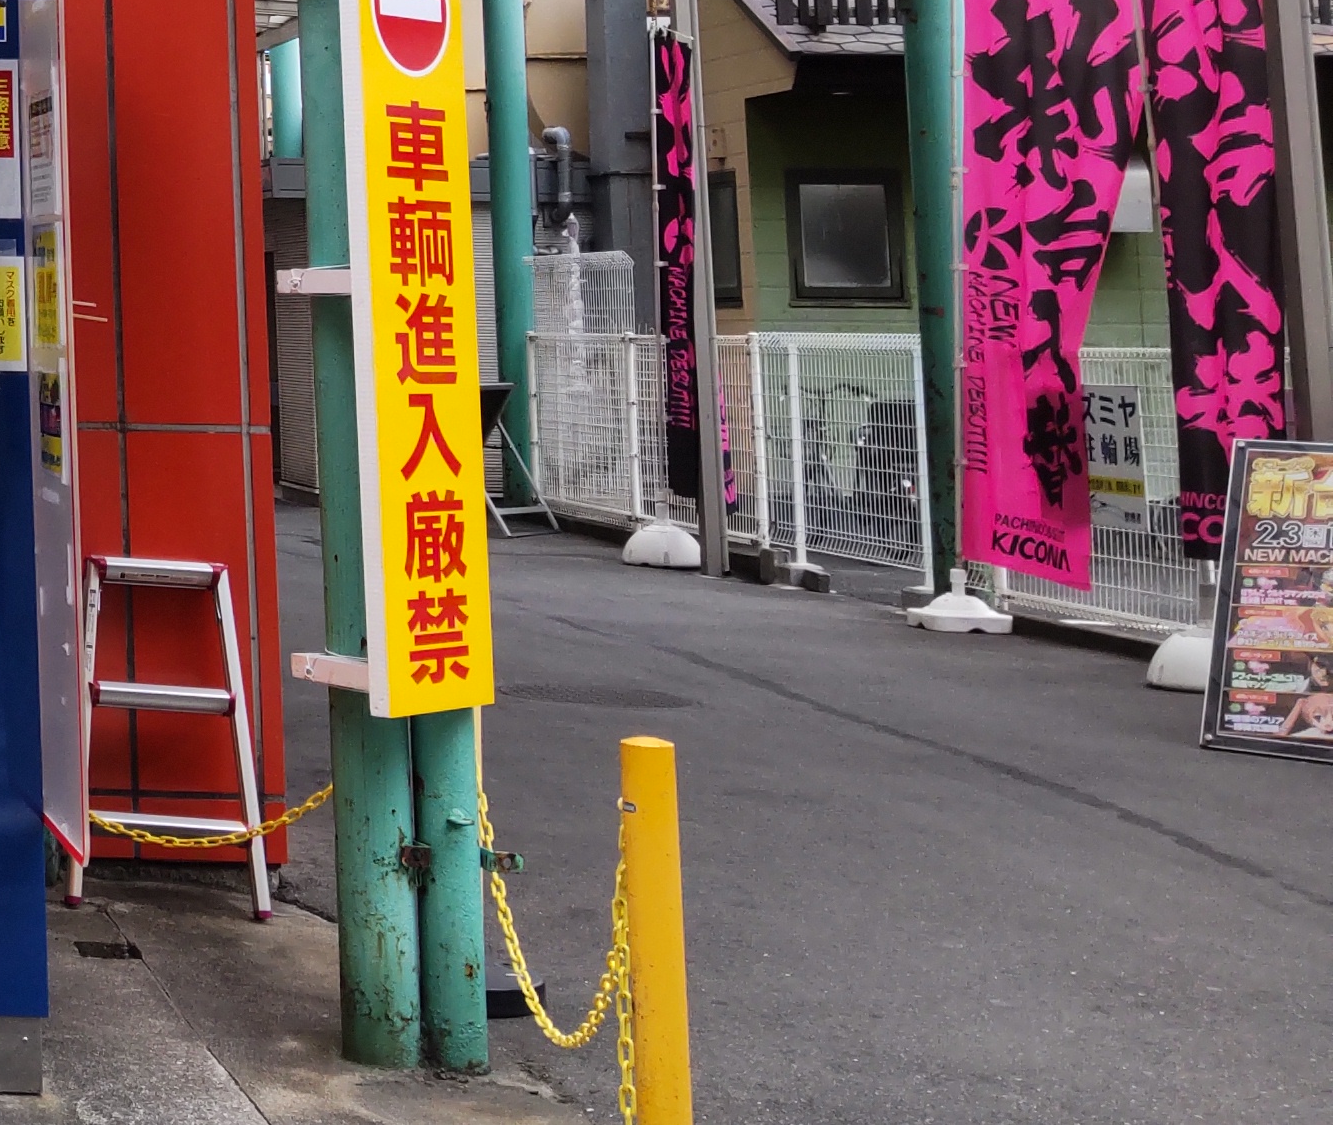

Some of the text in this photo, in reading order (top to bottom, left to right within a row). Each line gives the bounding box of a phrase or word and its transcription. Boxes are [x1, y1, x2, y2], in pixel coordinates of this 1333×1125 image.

[967, 271, 989, 363] MACHINE
[988, 275, 1021, 349] NEW
[386, 100, 470, 688] 車輌進入厳禁
[1244, 548, 1286, 562] NEW
